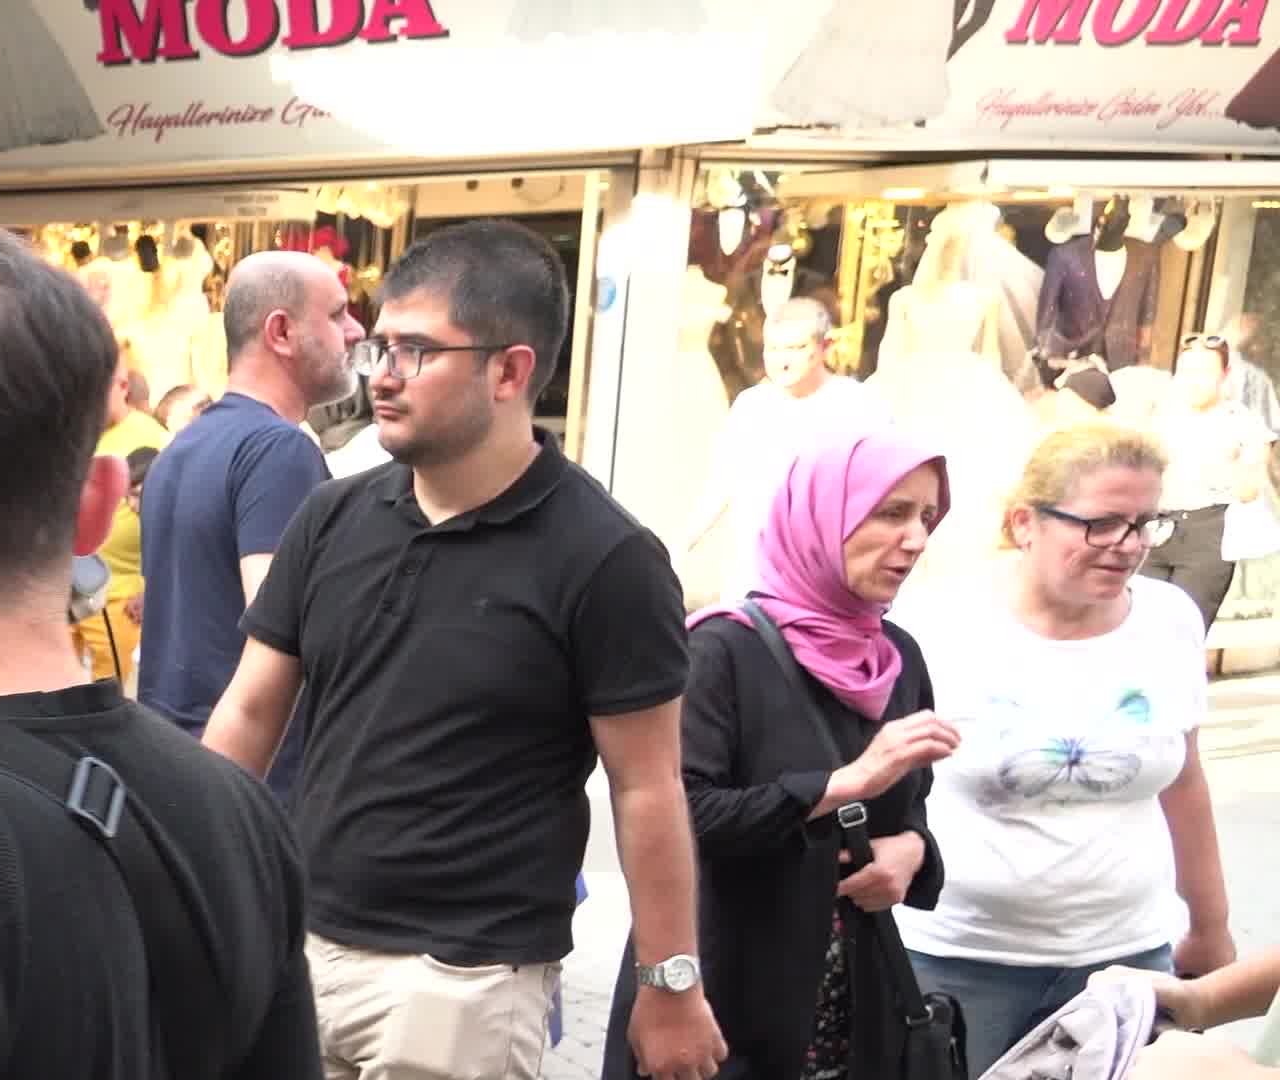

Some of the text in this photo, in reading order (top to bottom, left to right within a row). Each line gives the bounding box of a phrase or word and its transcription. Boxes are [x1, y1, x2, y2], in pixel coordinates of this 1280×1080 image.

[96, 0, 450, 66] MODA
[1004, 0, 1269, 47] MODA
[106, 101, 273, 143] Hayallerinize
